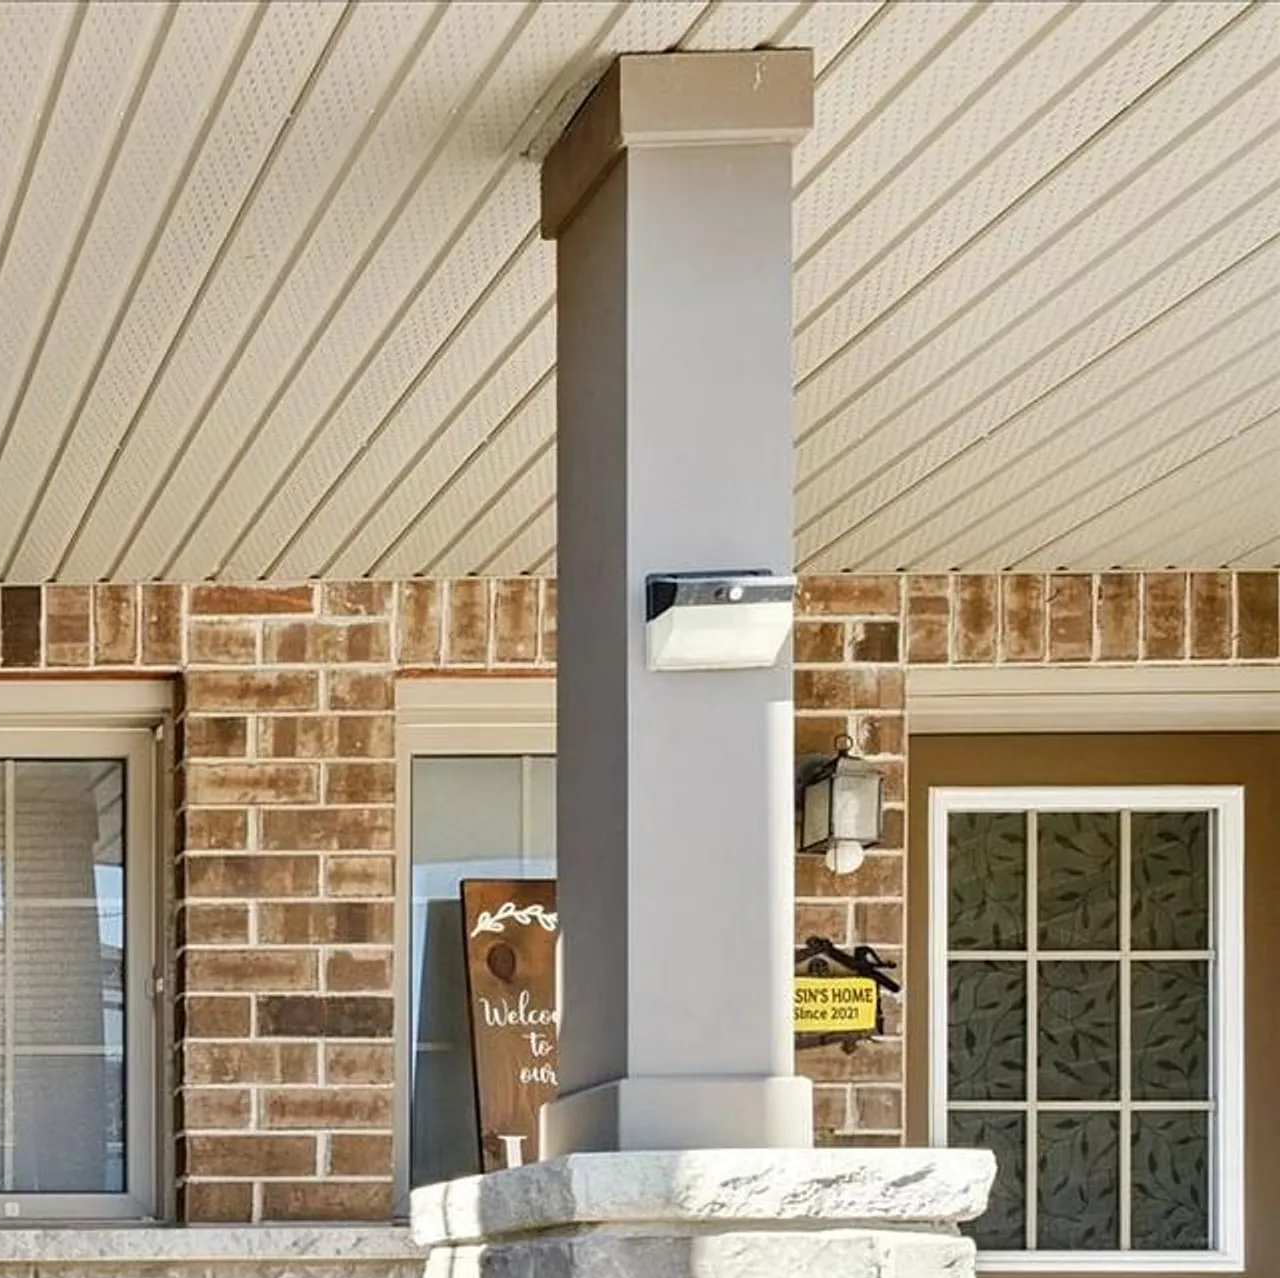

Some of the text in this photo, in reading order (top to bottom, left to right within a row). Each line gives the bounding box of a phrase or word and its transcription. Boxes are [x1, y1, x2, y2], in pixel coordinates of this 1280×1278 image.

[794, 987, 874, 1004] SIN'S HOME
[478, 989, 559, 1028] Welco
[793, 1006, 860, 1020] Since 2021
[521, 1031, 555, 1058] to
[519, 1062, 559, 1086] our
